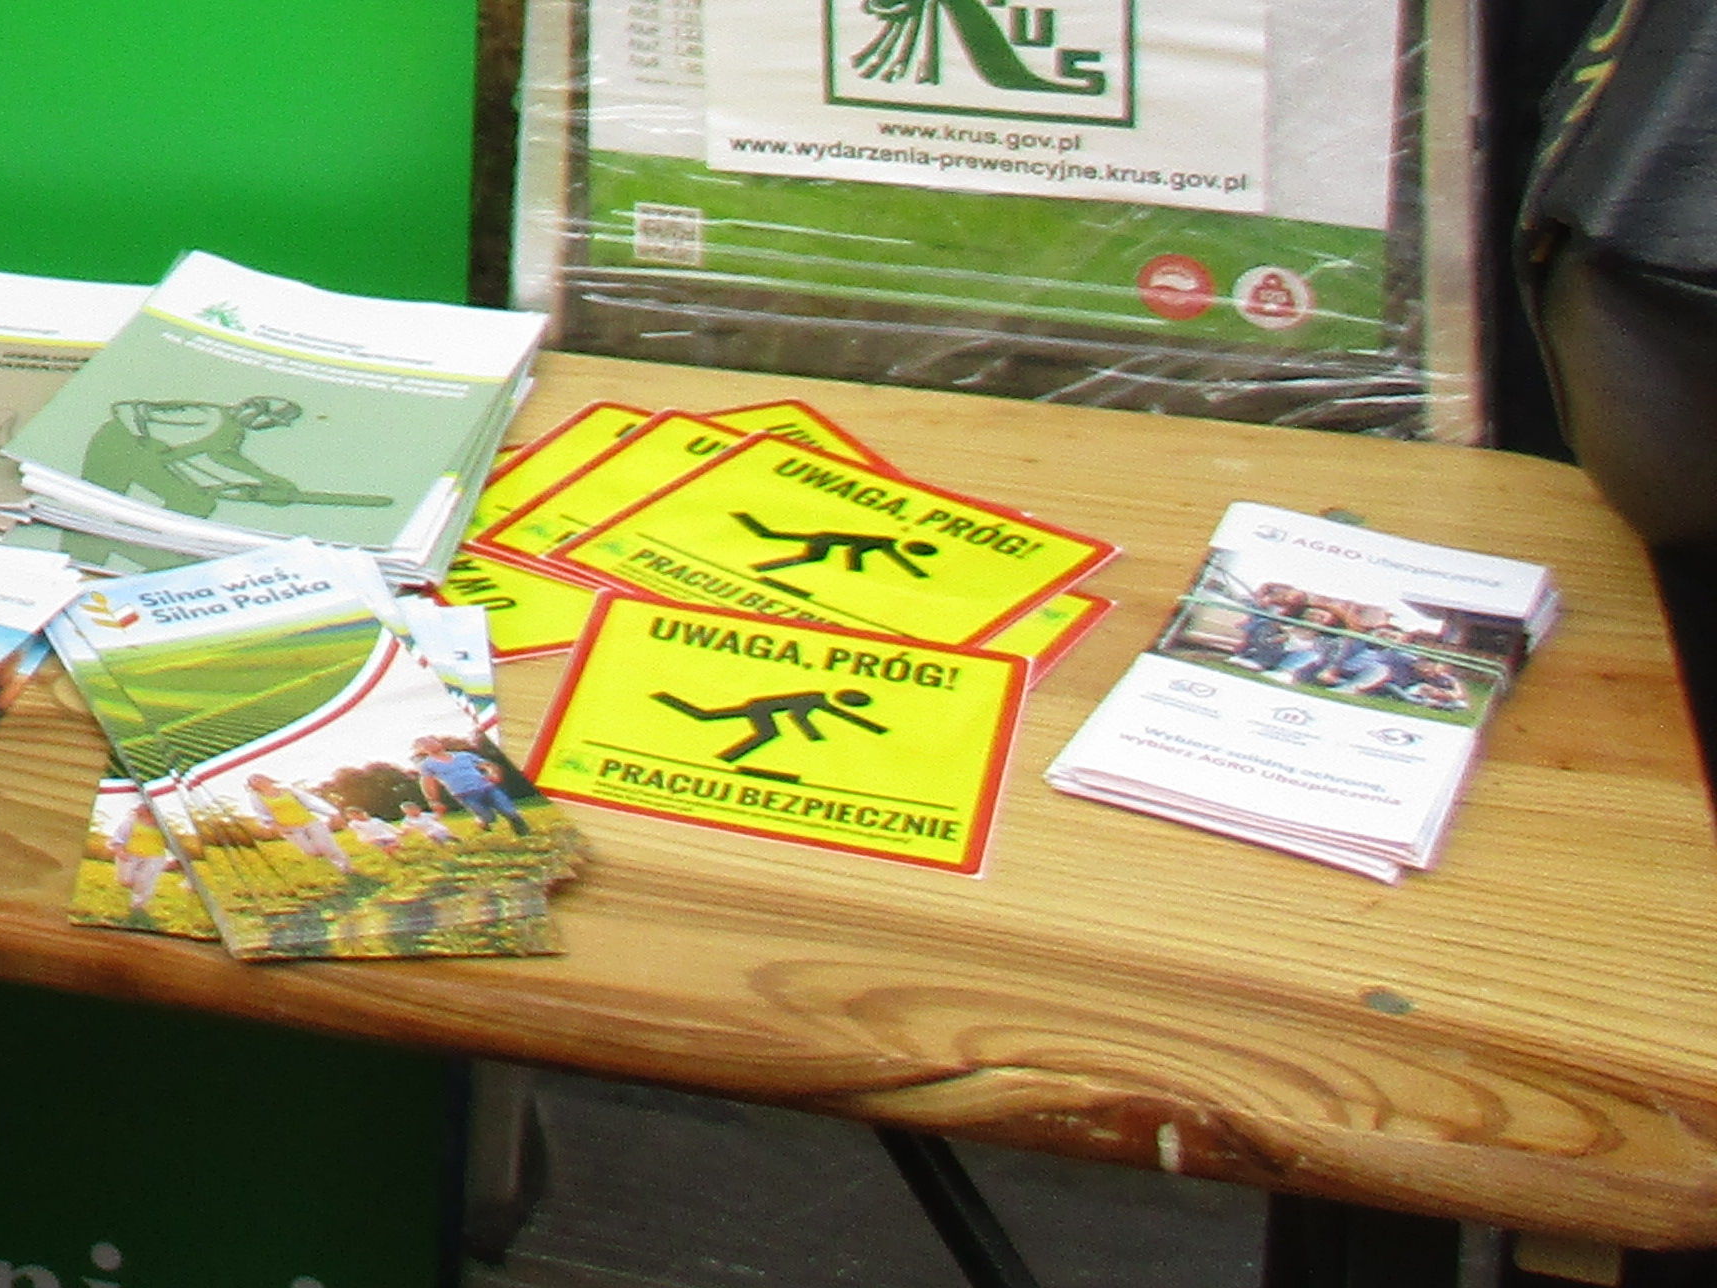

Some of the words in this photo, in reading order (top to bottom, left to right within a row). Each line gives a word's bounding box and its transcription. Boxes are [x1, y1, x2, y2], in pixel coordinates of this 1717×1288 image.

[876, 119, 1083, 153] www.krus.gov.pl
[914, 508, 1044, 560] PRÓG!
[1292, 536, 1362, 560] AGRO
[628, 547, 744, 600] PRACUJ
[138, 587, 215, 608] Silna
[150, 602, 228, 624] Silna
[230, 579, 332, 609] Polska
[821, 644, 961, 691] PRÓG!
[1197, 753, 1257, 775] AGRO
[598, 757, 730, 803] PRACUJ
[735, 785, 965, 843] BEZPIECZNIE
